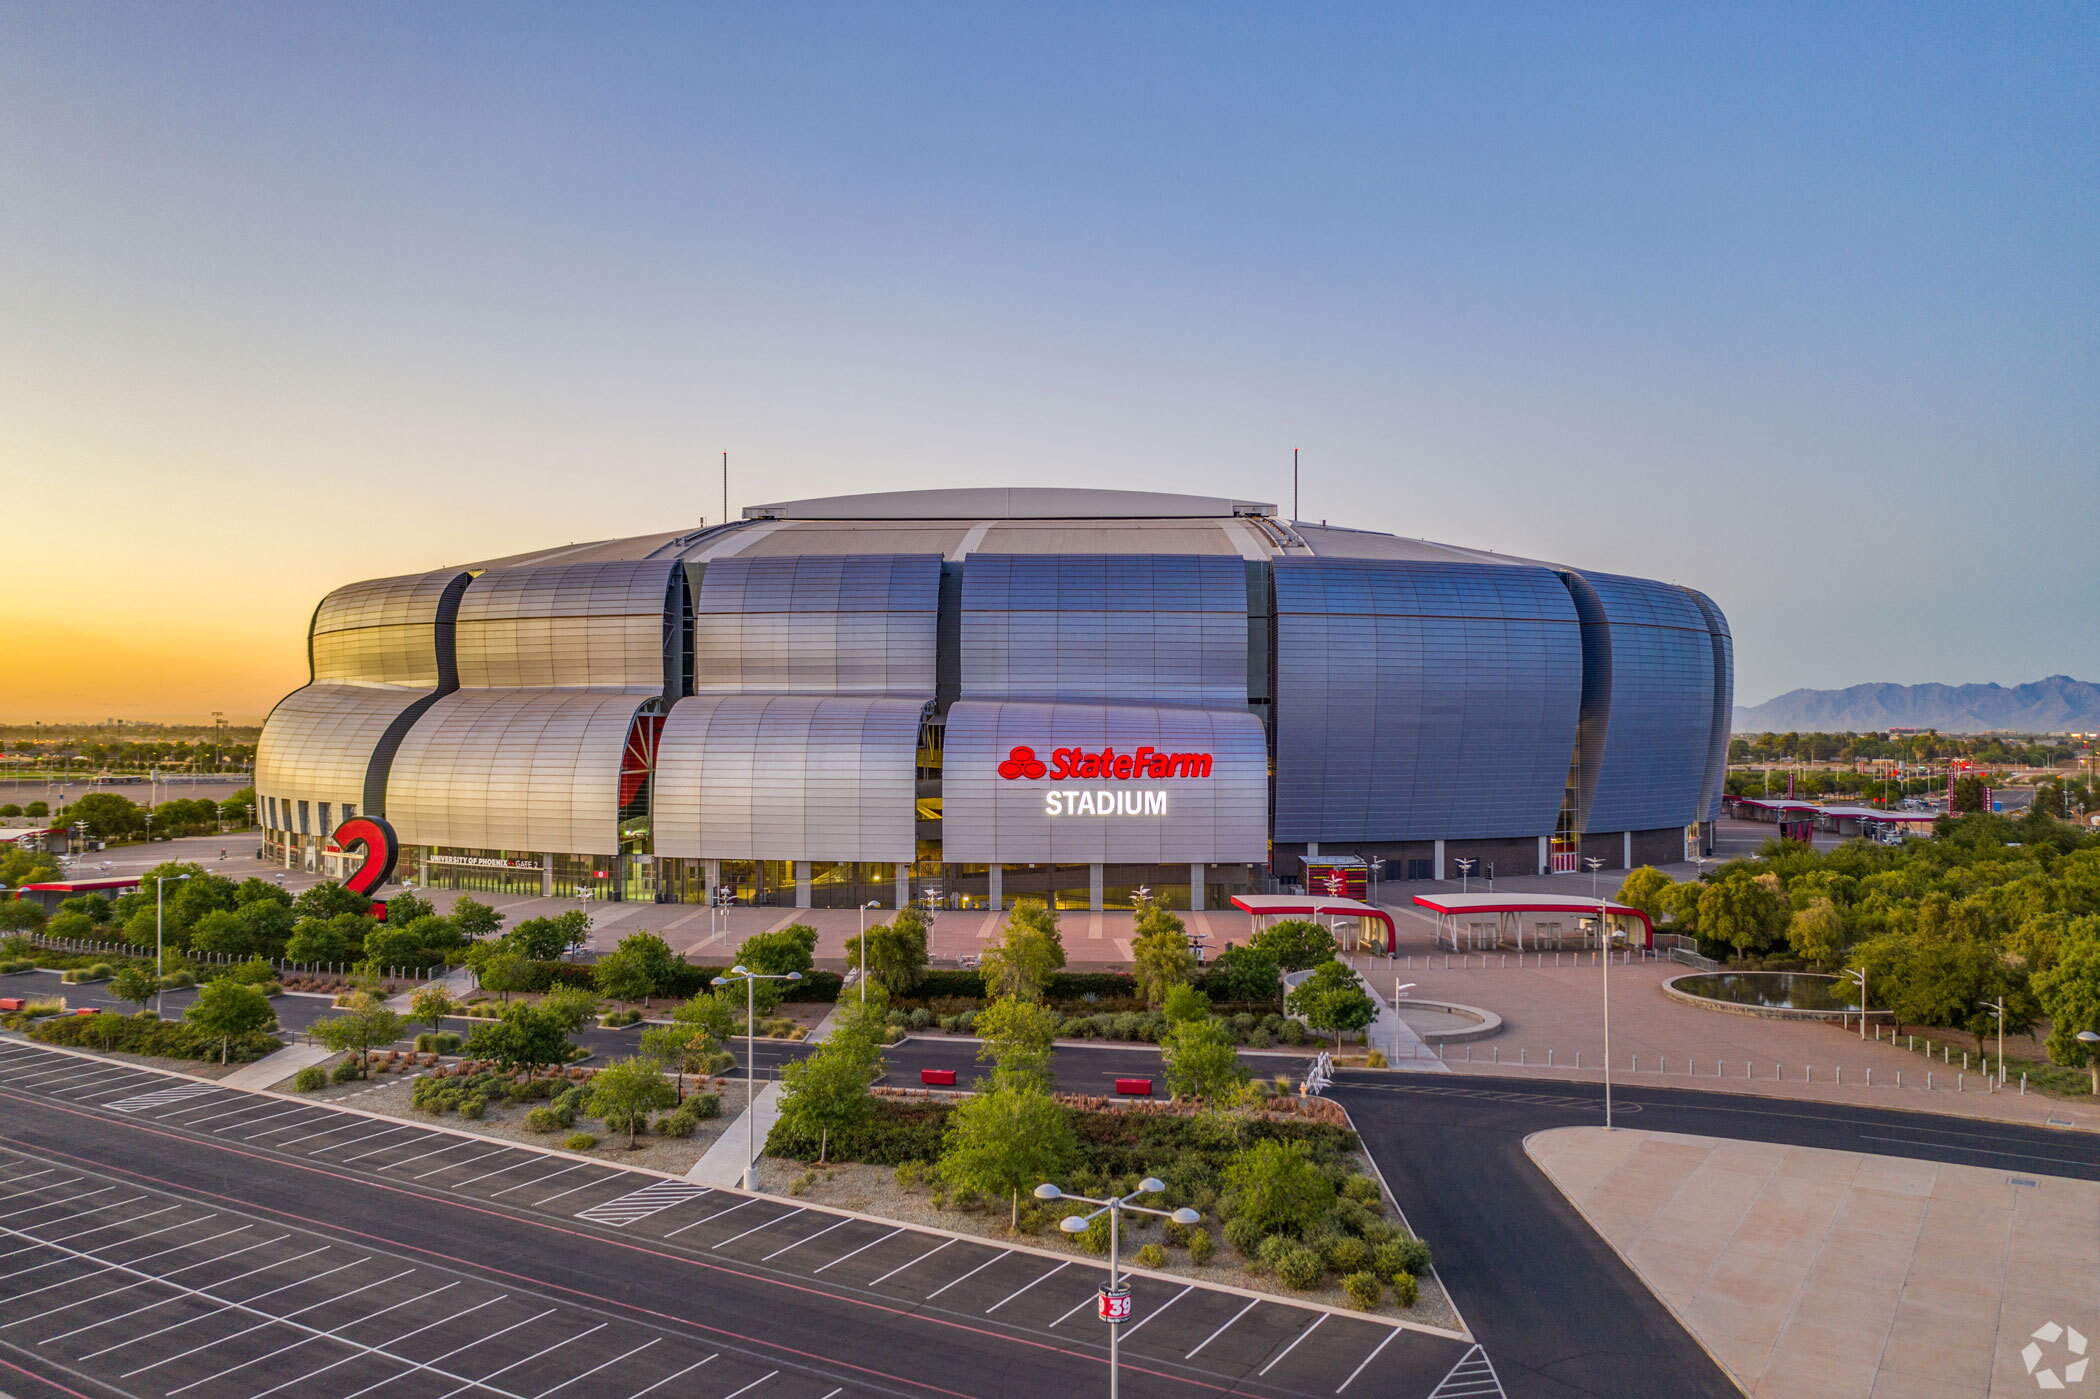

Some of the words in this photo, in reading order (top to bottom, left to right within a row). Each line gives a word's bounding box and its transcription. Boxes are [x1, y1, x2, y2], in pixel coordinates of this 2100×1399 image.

[1045, 790, 1167, 815] STADIUM
[430, 855, 467, 864] UNIVERSITY
[478, 858, 508, 866] PHOENIX
[515, 860, 533, 868] GATE
[1109, 1298, 1131, 1315] 39
